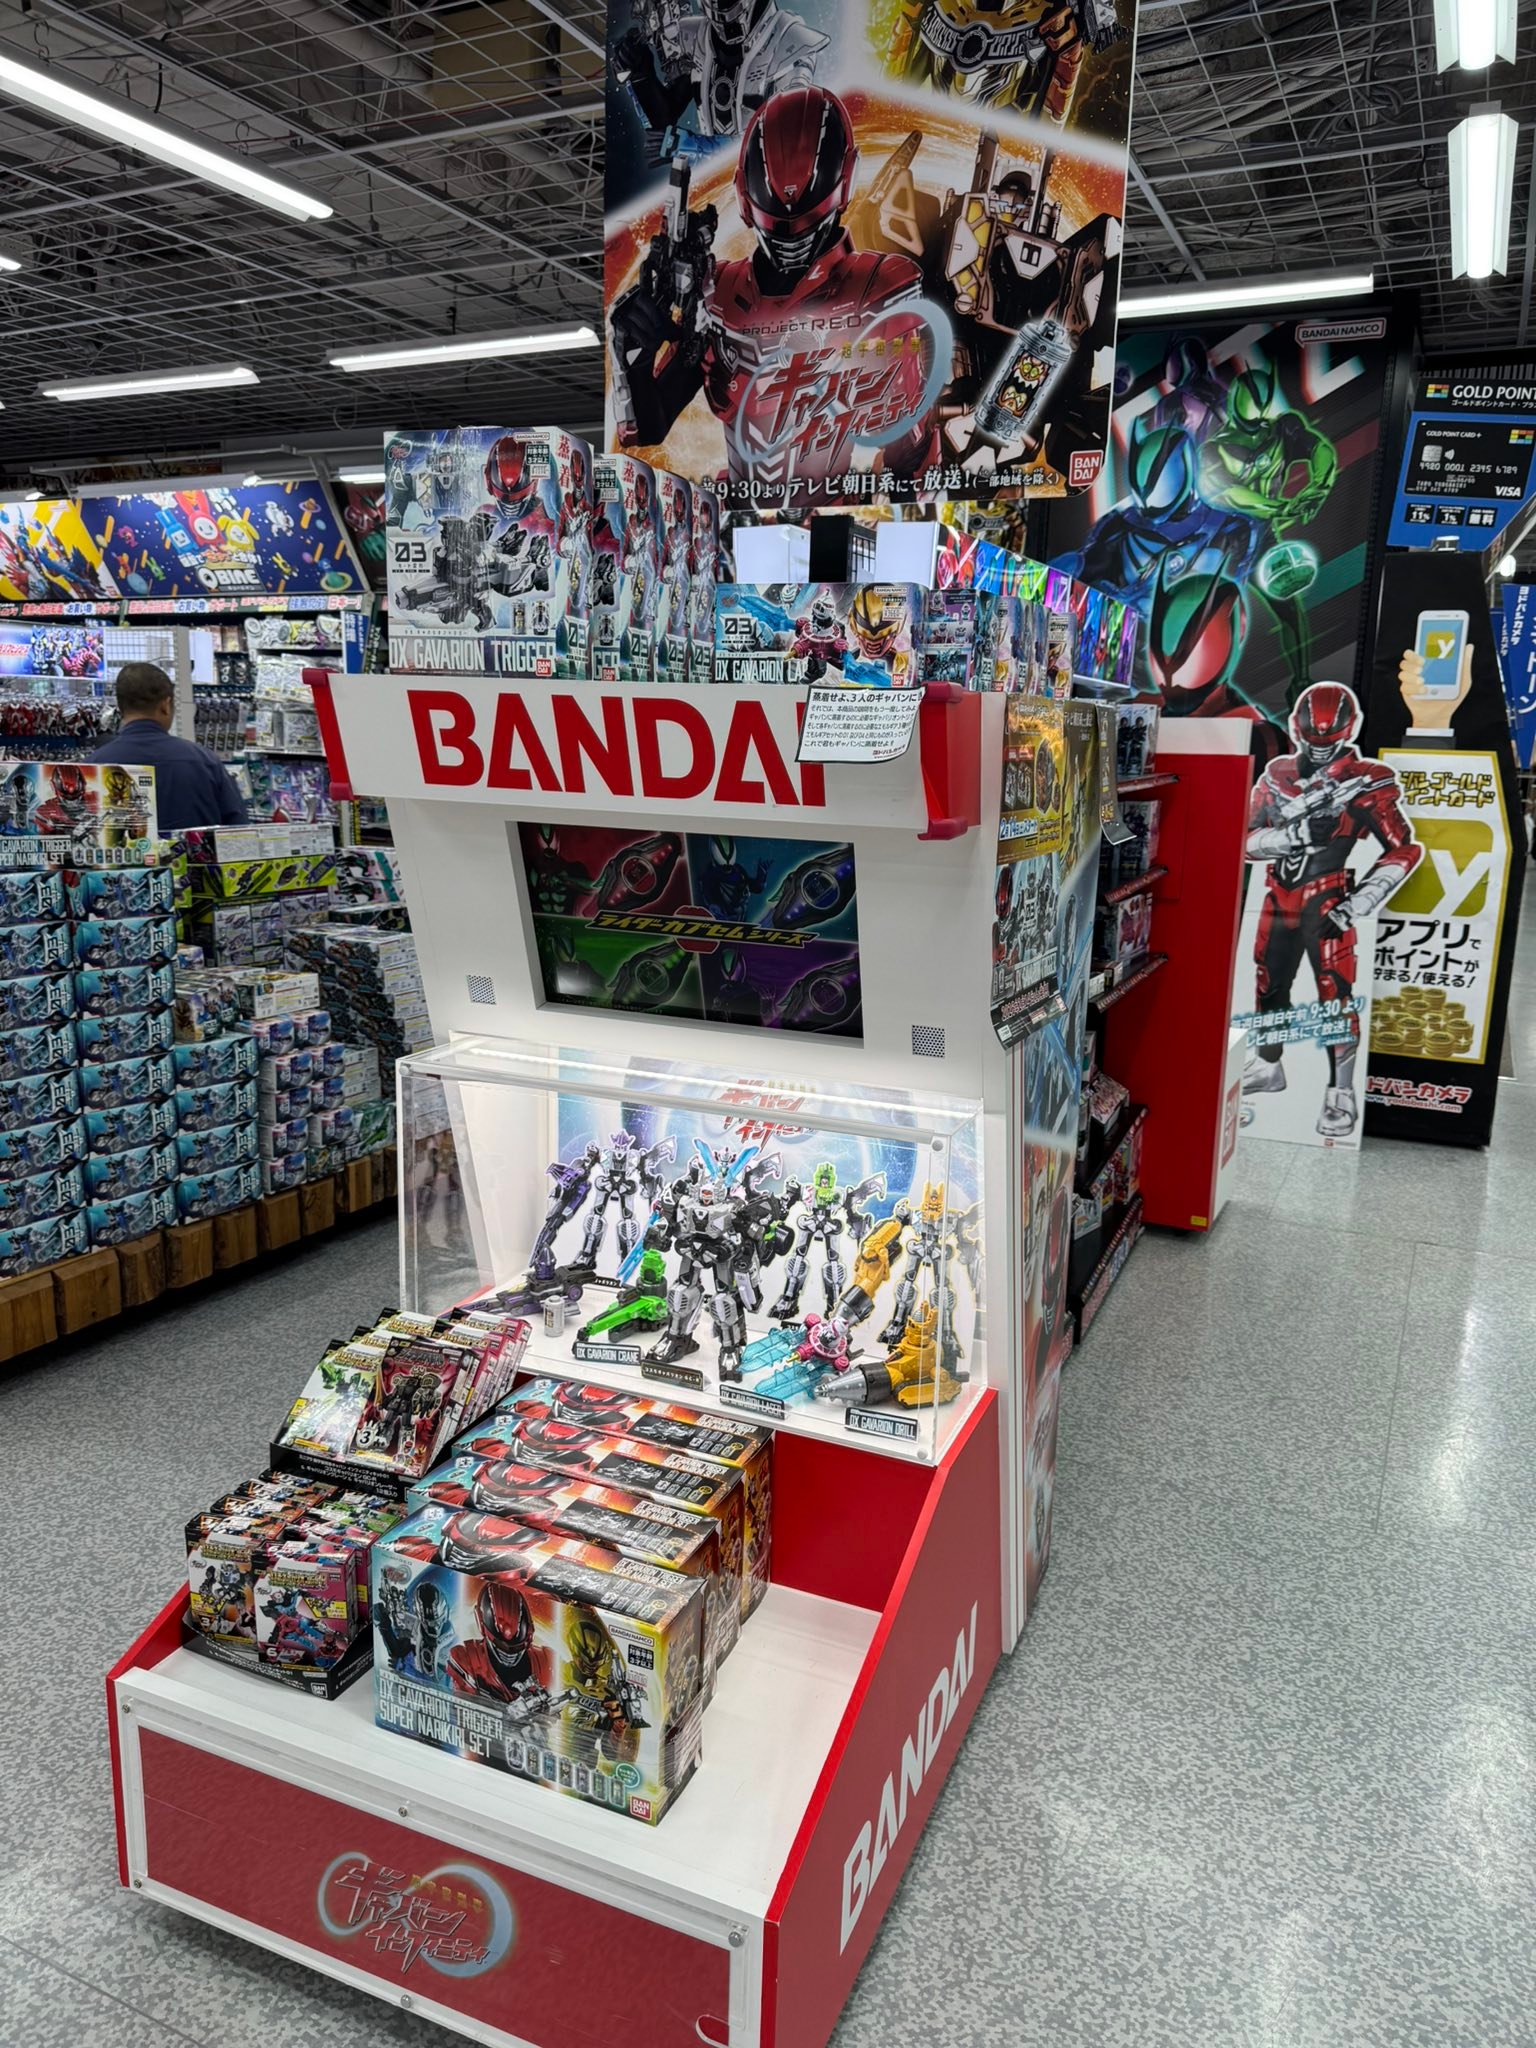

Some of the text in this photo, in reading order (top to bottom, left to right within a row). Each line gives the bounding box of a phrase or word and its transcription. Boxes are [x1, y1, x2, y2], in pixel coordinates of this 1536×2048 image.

[742, 315, 865, 336] PROJECT R.E.D.
[1302, 324, 1380, 339] BANDAI NAMCO
[755, 347, 904, 444] ギャバン
[1452, 384, 1493, 399] GOLD
[790, 392, 928, 473] インフィニティ
[557, 434, 571, 488] 蒸着
[1074, 456, 1100, 469] BAN
[1073, 468, 1095, 481] DAI
[623, 460, 636, 510] 蒸着
[1495, 486, 1521, 497] VISA
[1412, 511, 1430, 520] 11%
[395, 542, 427, 562] 03
[569, 622, 587, 649] 03
[725, 618, 751, 635] 03
[389, 638, 408, 669] DX
[413, 639, 485, 671] GAVARION
[631, 632, 649, 658] 03
[715, 660, 729, 681] DX
[732, 660, 784, 682] GAVARION
[40, 839, 72, 852] TRIGGER
[50, 852, 65, 865] SET
[1376, 919, 1482, 950] アプリで
[1374, 948, 1480, 973] ポイントが
[1246, 1018, 1352, 1048] レビ朝日系にて放送!
[1366, 1076, 1473, 1104] ドバシカメラ
[576, 1347, 639, 1363] DX GAVARION CRANE
[849, 1414, 916, 1438] DX GAVARION DRILL
[359, 1431, 372, 1444] 3
[201, 1616, 210, 1626] 3
[610, 1627, 653, 1644] BANDAI NAMCO
[266, 1647, 279, 1657] 6
[379, 1679, 504, 1740] DX GAVARION TRIGGER
[379, 1699, 493, 1759] SUPER NARIKIRI SET
[840, 1599, 978, 1957] BANDAI
[632, 1798, 651, 1809] BAN
[632, 1806, 647, 1816] DAI
